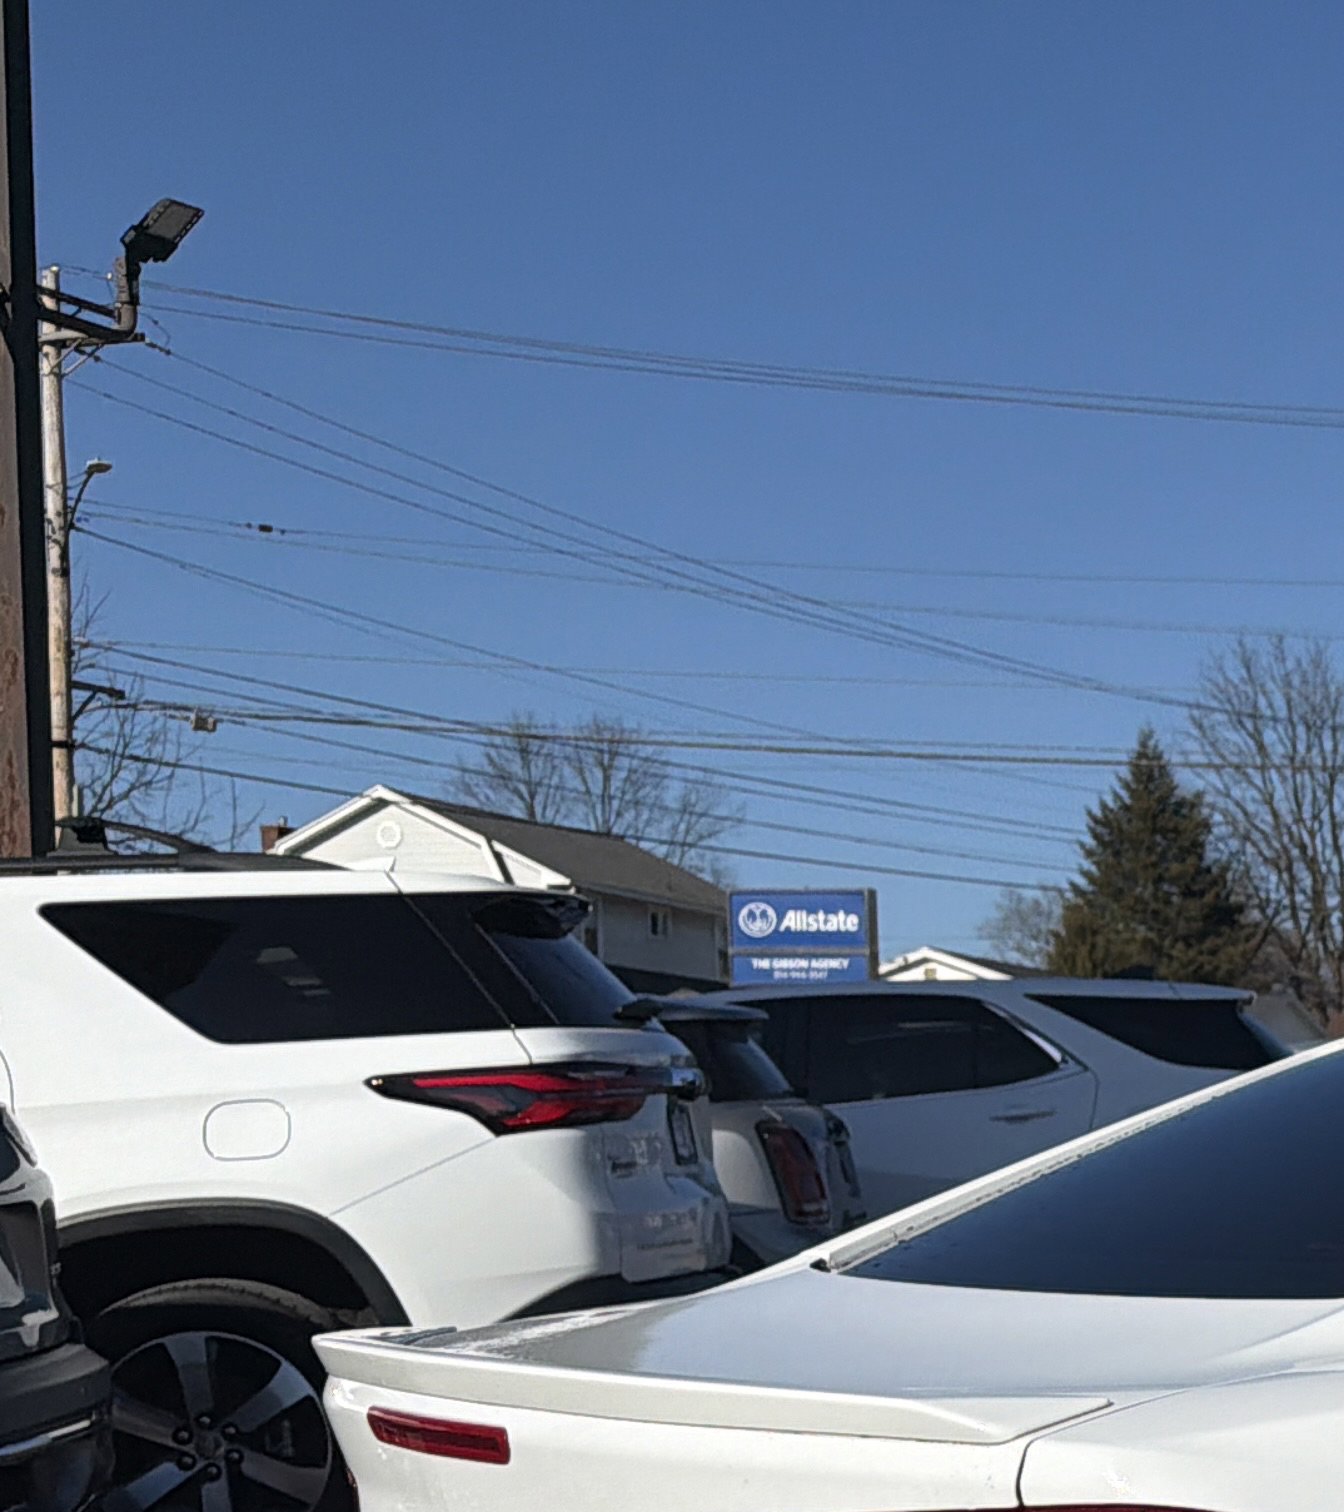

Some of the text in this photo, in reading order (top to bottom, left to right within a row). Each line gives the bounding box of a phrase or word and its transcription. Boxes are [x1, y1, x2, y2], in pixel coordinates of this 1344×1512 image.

[779, 909, 860, 933] Allstate
[752, 957, 770, 970] THE
[811, 957, 850, 970] AGENCY
